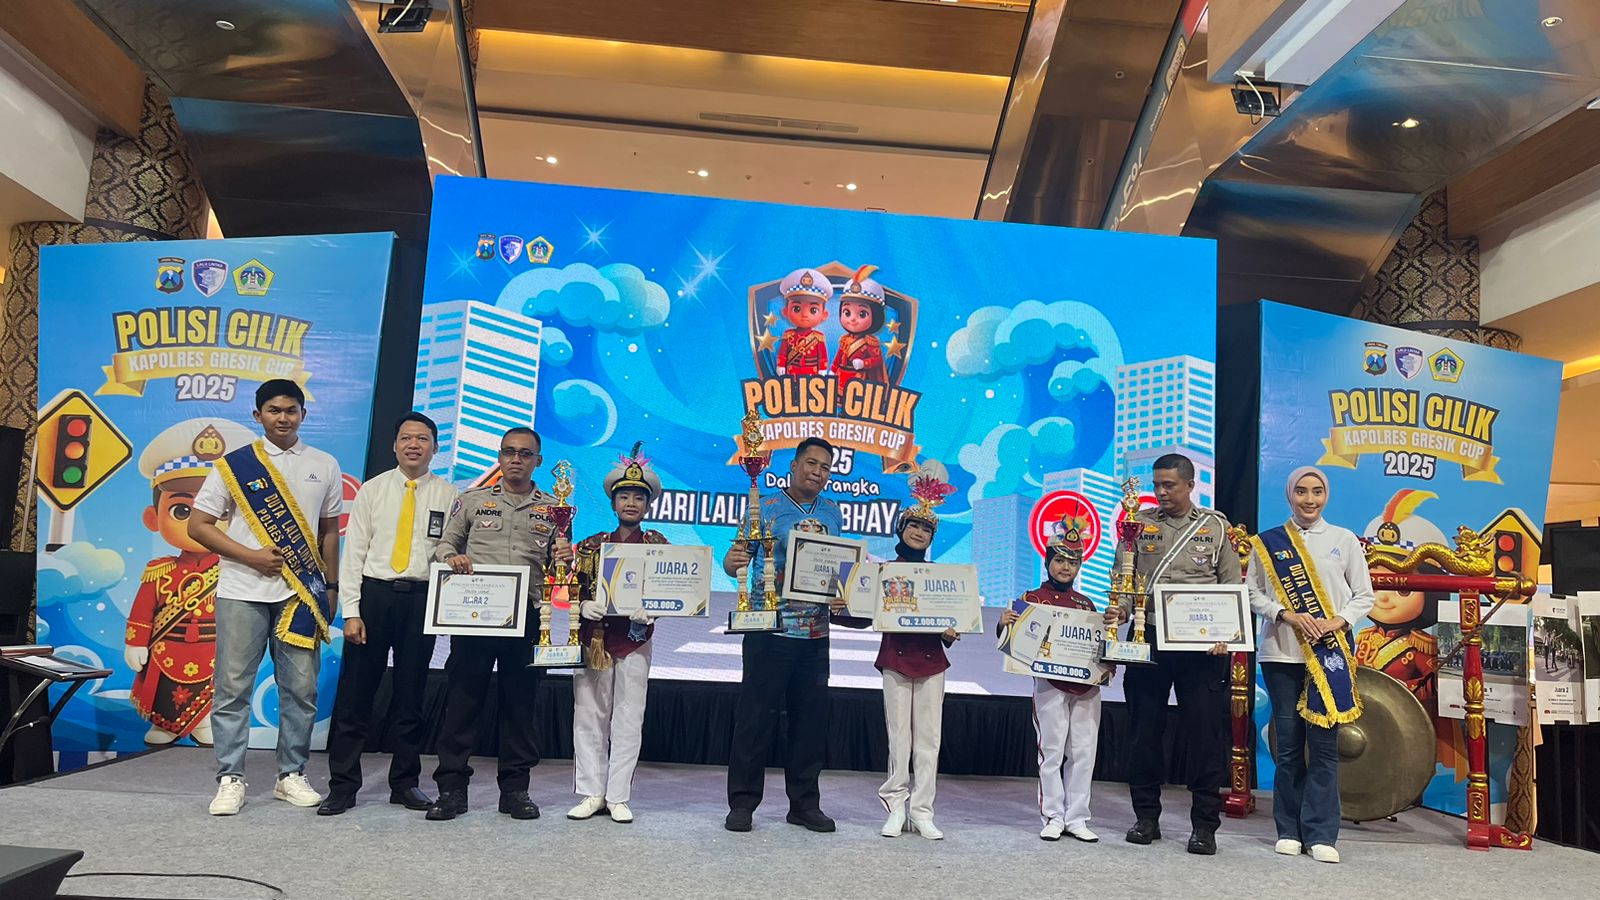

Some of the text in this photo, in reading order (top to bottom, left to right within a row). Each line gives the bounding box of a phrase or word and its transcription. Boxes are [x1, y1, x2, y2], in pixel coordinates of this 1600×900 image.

[115, 308, 309, 357] POLISI CILIK
[128, 350, 296, 378] KAPOLRES GRESIK CUP
[176, 374, 237, 401] 2025
[743, 378, 919, 429] POLISI CILIK
[1331, 389, 1496, 442] POLISI CILIK
[828, 422, 875, 445] GRESIK
[879, 430, 906, 451] CUP
[1343, 429, 1485, 460] KAPOLRES GRESIK CUP
[1384, 452, 1436, 480] 2025
[475, 509, 502, 517] ANDRE
[256, 507, 303, 577] POLRES GRESIK
[263, 493, 319, 576] DUTA LALU LINTAS
[654, 561, 698, 576] JUARA 2
[813, 564, 830, 574] JUARA
[923, 579, 966, 592] JUARA 1
[1280, 576, 1302, 611] POLRES
[1288, 563, 1308, 587] DUTA
[1301, 589, 1321, 614] LALU
[462, 596, 489, 605] JUARA 2
[1188, 613, 1214, 622] JUARA 3
[1060, 624, 1102, 643] JUARA 3
[1033, 660, 1046, 672] Rp.
